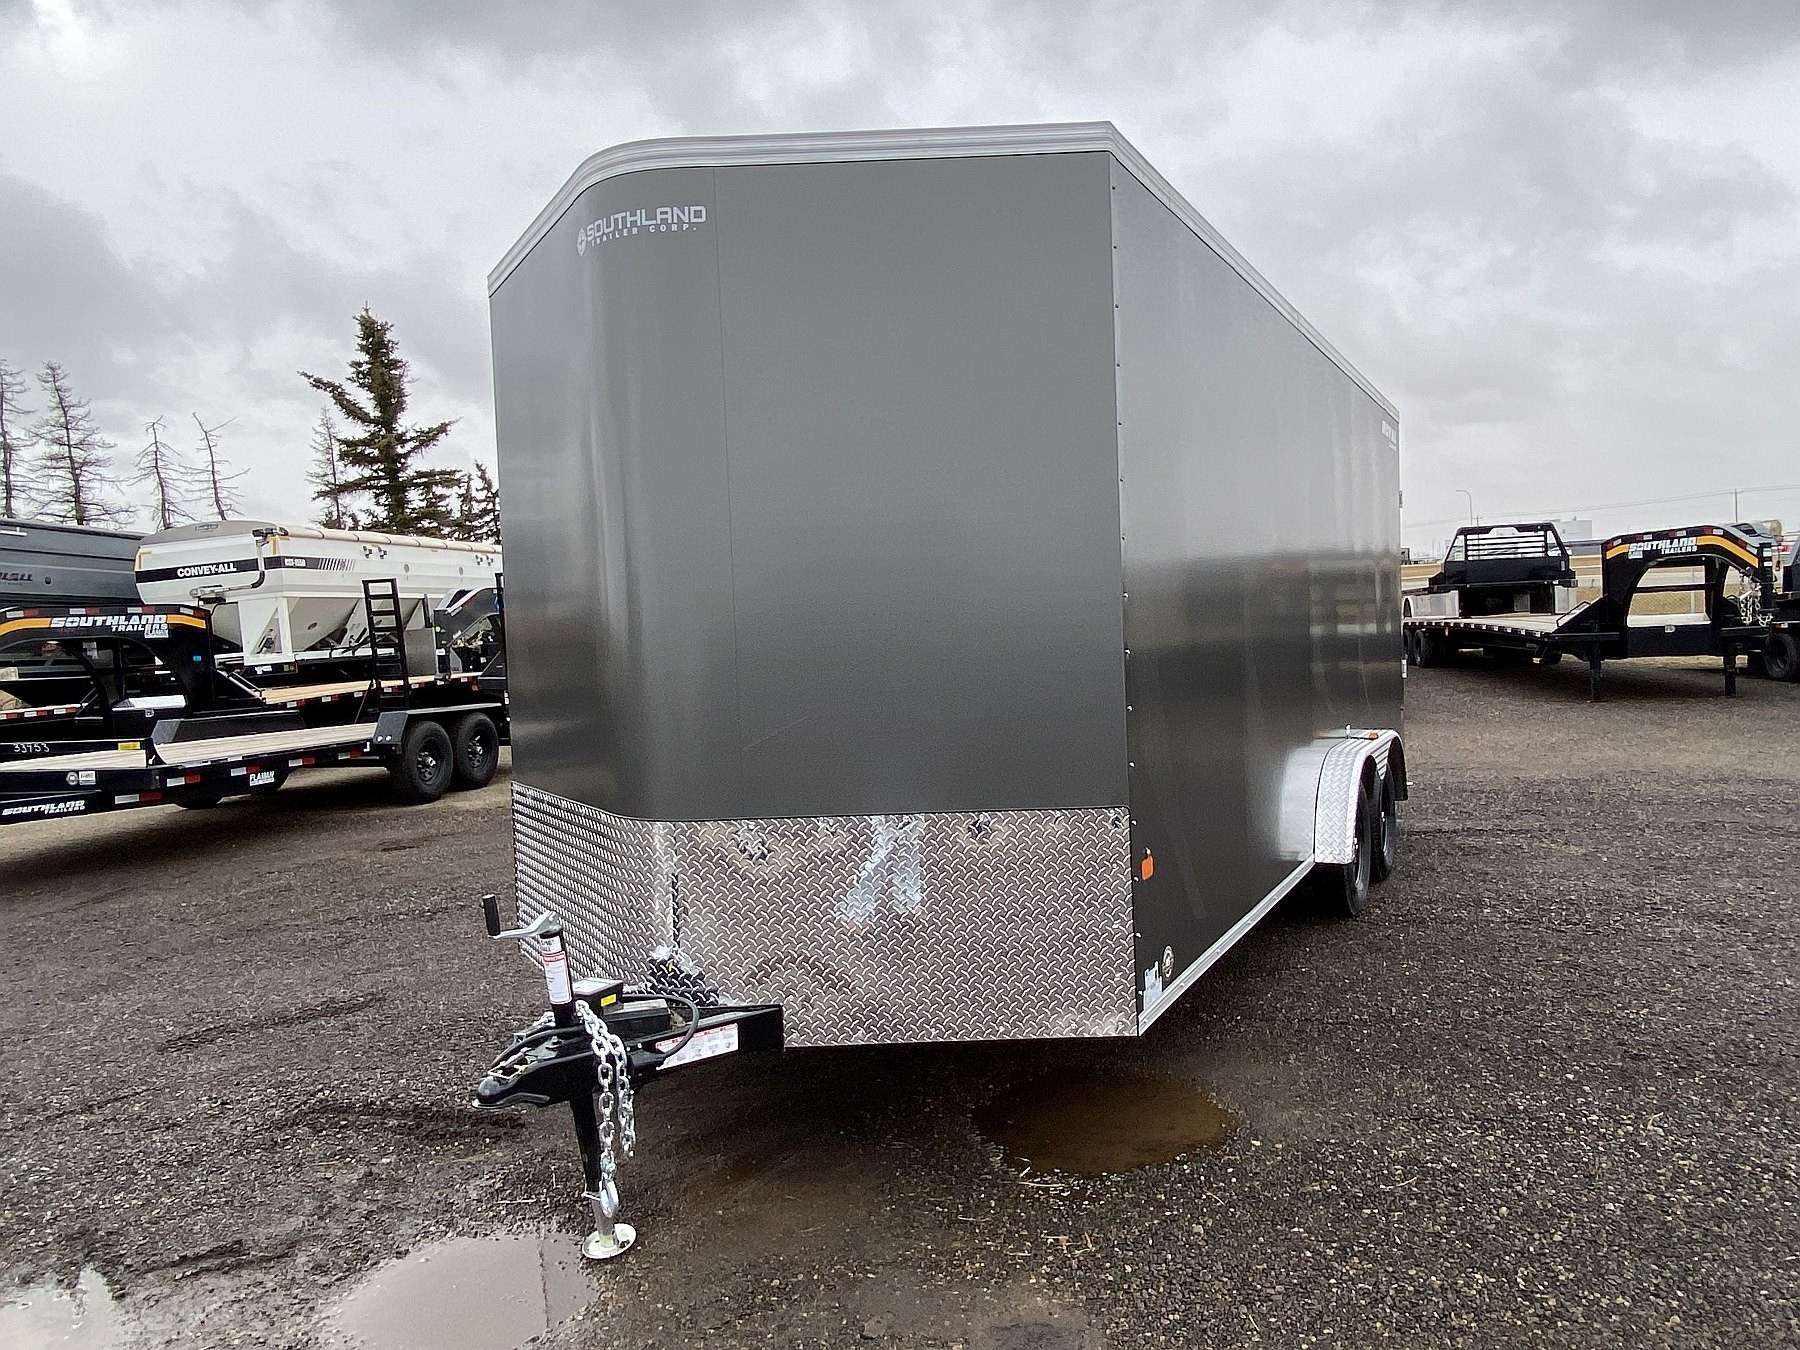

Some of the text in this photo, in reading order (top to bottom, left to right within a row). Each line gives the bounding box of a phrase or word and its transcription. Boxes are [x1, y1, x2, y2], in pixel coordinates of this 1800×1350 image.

[586, 206, 706, 242] SOUTHLAND
[591, 223, 697, 247] TRAILER CORP.
[1628, 537, 1697, 552] SOUTHLAND
[177, 562, 236, 577] CONVEY-ALL
[50, 614, 167, 628] SOUTHLAND
[111, 623, 168, 632] TRAILRS
